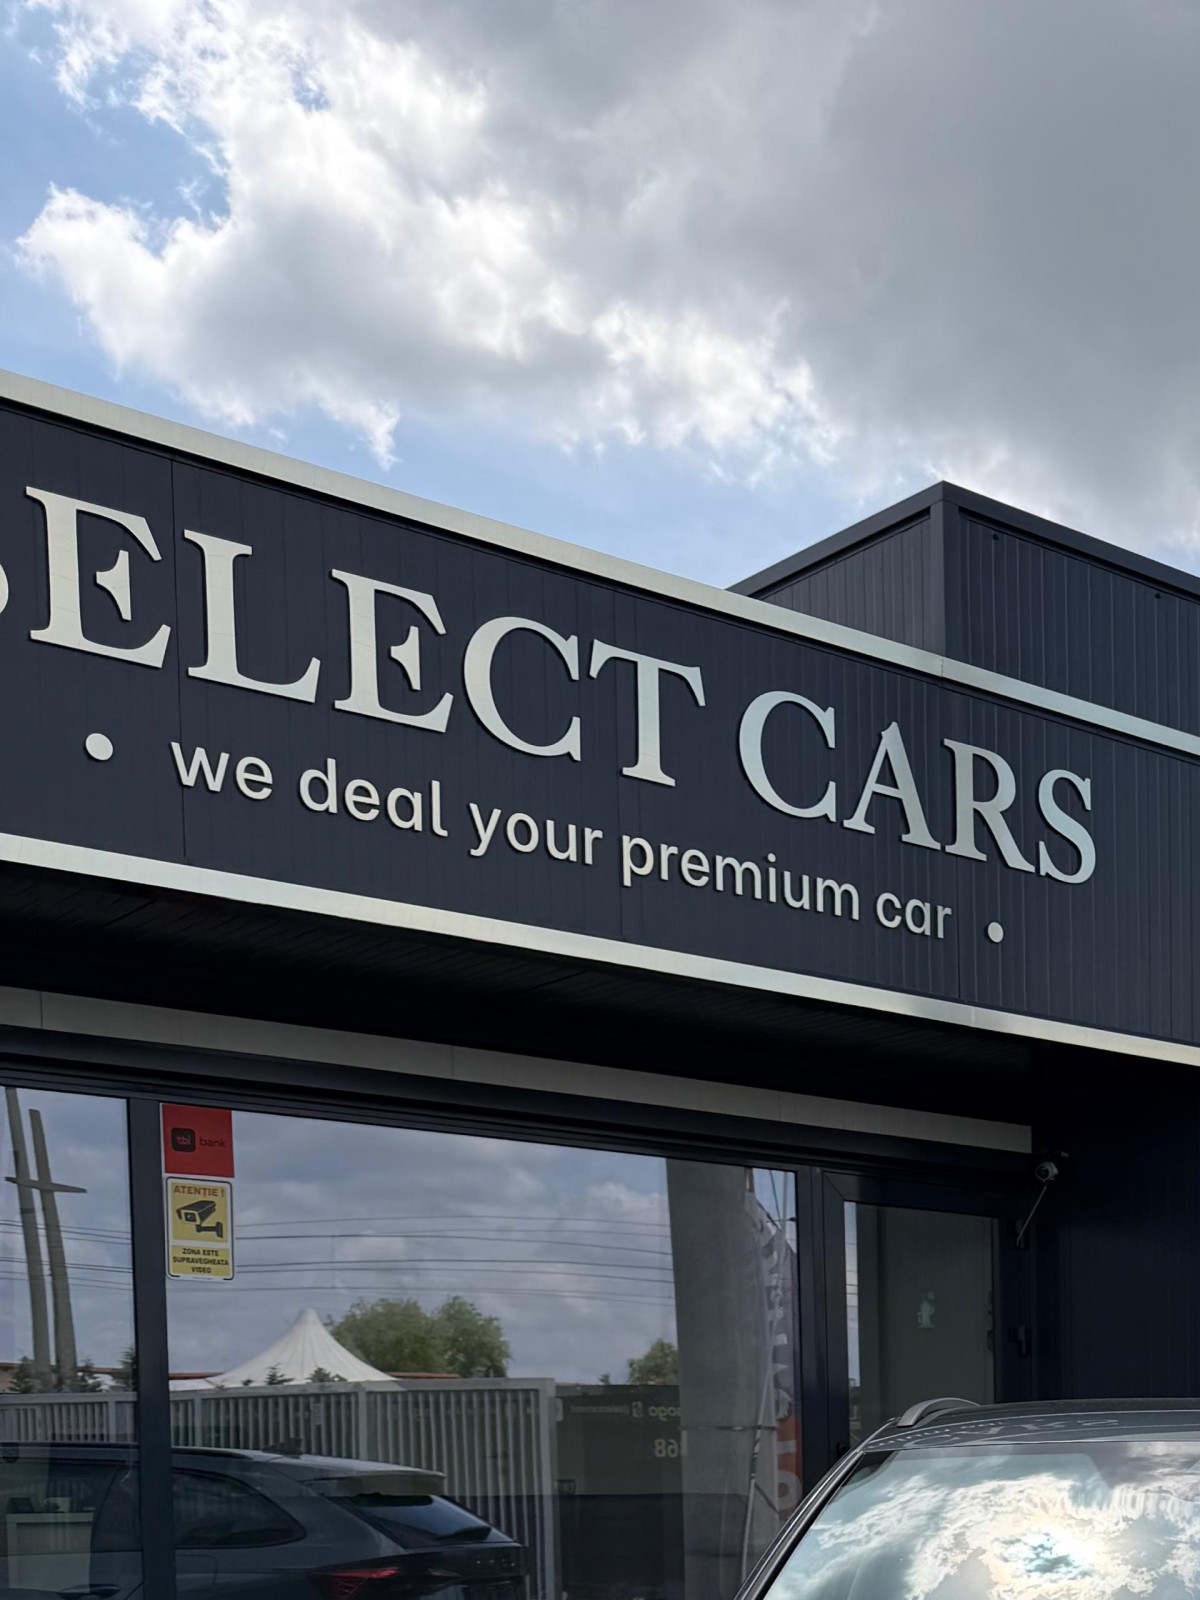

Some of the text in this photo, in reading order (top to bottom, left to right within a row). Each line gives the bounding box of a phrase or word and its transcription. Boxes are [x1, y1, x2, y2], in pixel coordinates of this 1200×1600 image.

[0, 486, 1098, 885] ELECT CARS
[170, 741, 953, 940] we deal your premium car
[199, 1137, 227, 1148] bank
[182, 1247, 220, 1257] ZONA ESTE
[191, 1266, 212, 1274] VIDEO
